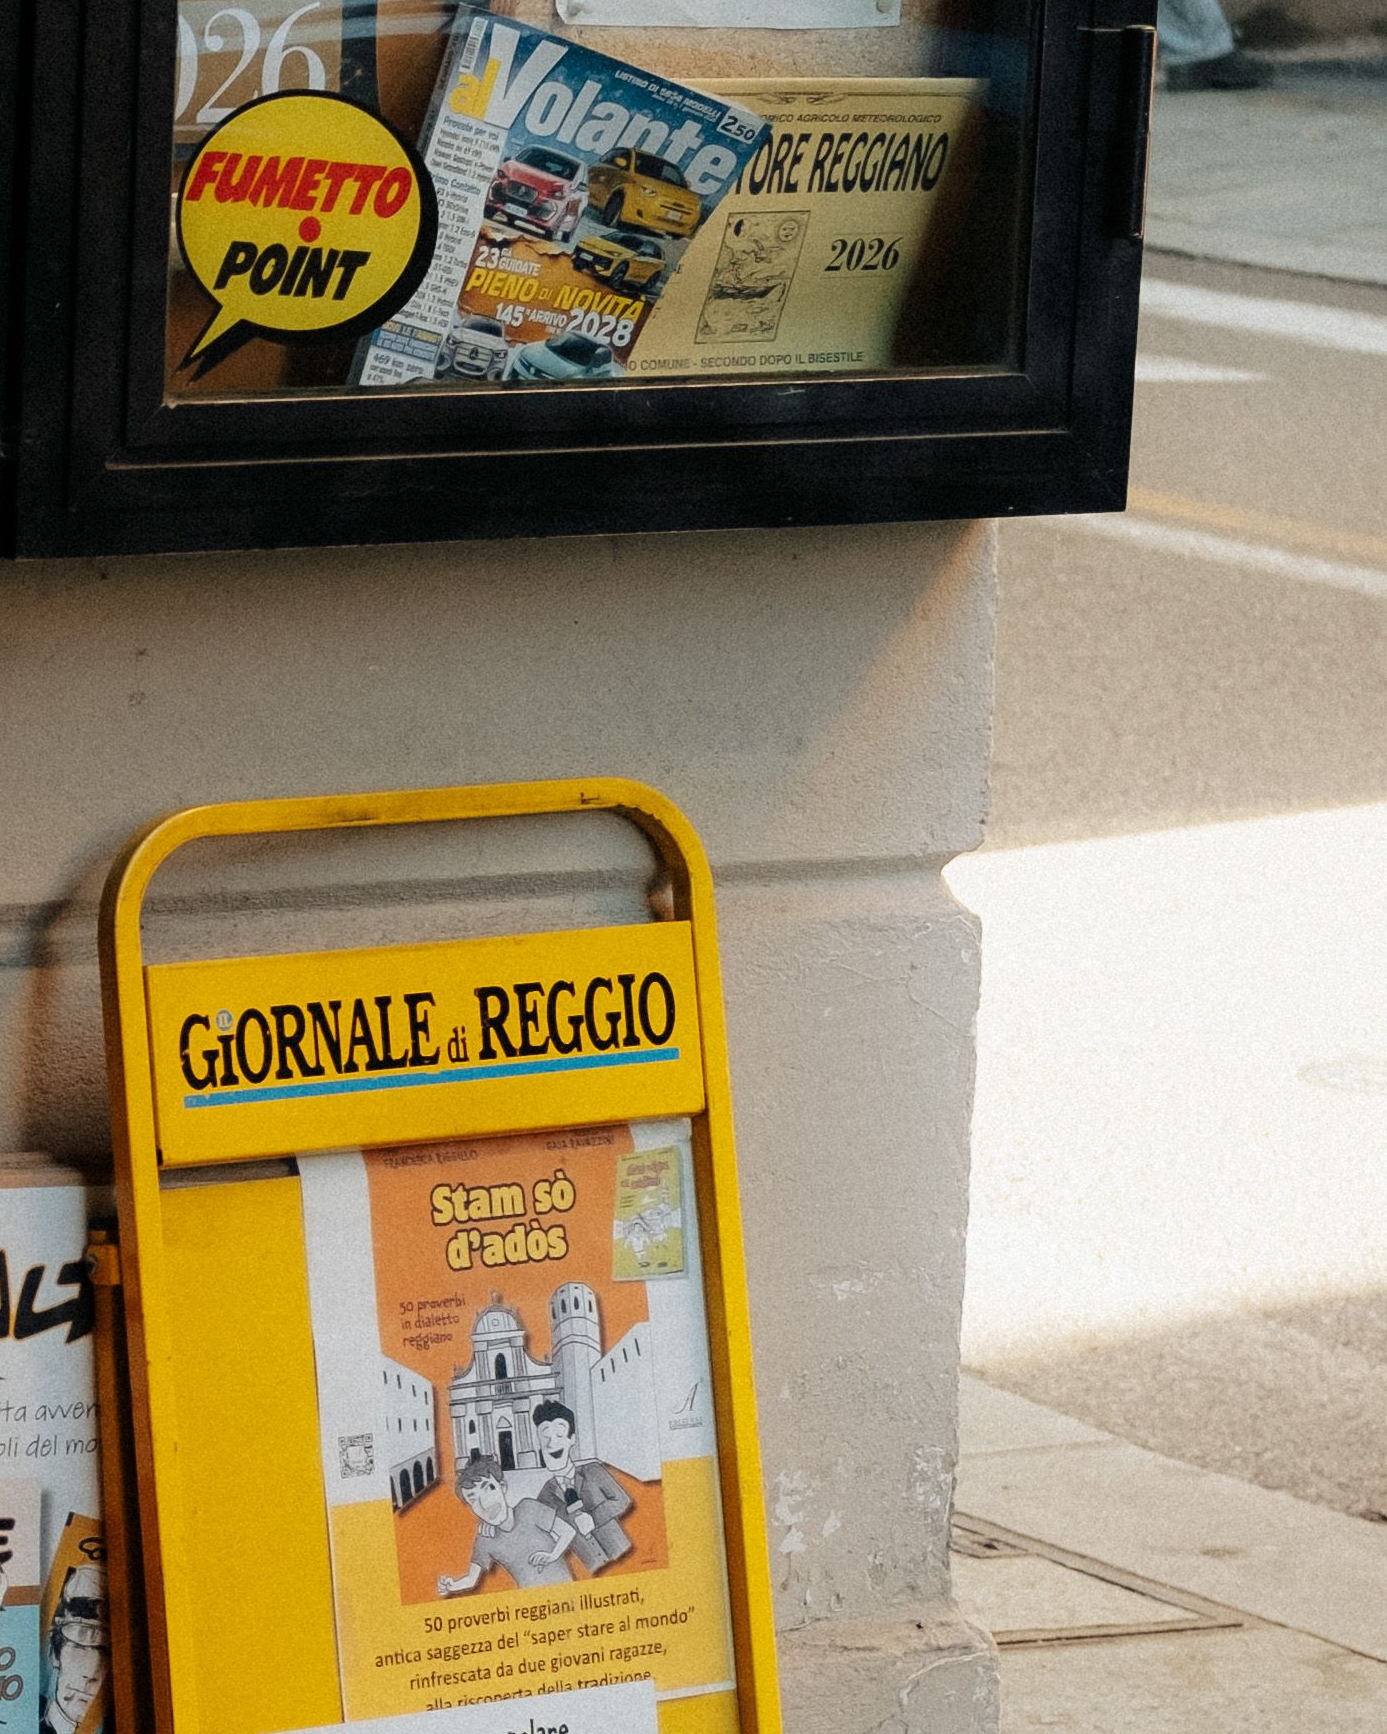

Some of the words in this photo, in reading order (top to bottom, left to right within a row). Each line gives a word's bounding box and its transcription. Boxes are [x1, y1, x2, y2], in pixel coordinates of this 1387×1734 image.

[485, 23, 737, 196] Volante
[796, 114, 849, 124] AGRICOLO
[851, 114, 942, 124] METEOROLOGICO
[185, 151, 412, 219] FUMETTO
[807, 132, 950, 193] REGGIANO
[213, 241, 371, 301] POINT
[824, 236, 904, 272] 2026
[465, 268, 539, 302] PIENO
[553, 284, 646, 324] NOVITÀ
[567, 307, 635, 347] 2028
[808, 351, 864, 364] BISESTILE
[447, 1027, 470, 1063] di
[474, 972, 676, 1060] REGGIO
[430, 1182, 527, 1226] Stam
[532, 1168, 576, 1215] sò
[446, 1218, 569, 1272] d'adòs
[424, 1617, 443, 1634] 50
[448, 1606, 510, 1634] proverbi
[515, 1601, 576, 1622] reggiani
[579, 1587, 645, 1611] illustrati,
[374, 1650, 422, 1668] antica
[426, 1639, 493, 1662] saggezza
[497, 1632, 521, 1650] del
[577, 1621, 615, 1639] stare
[618, 1616, 631, 1632] al
